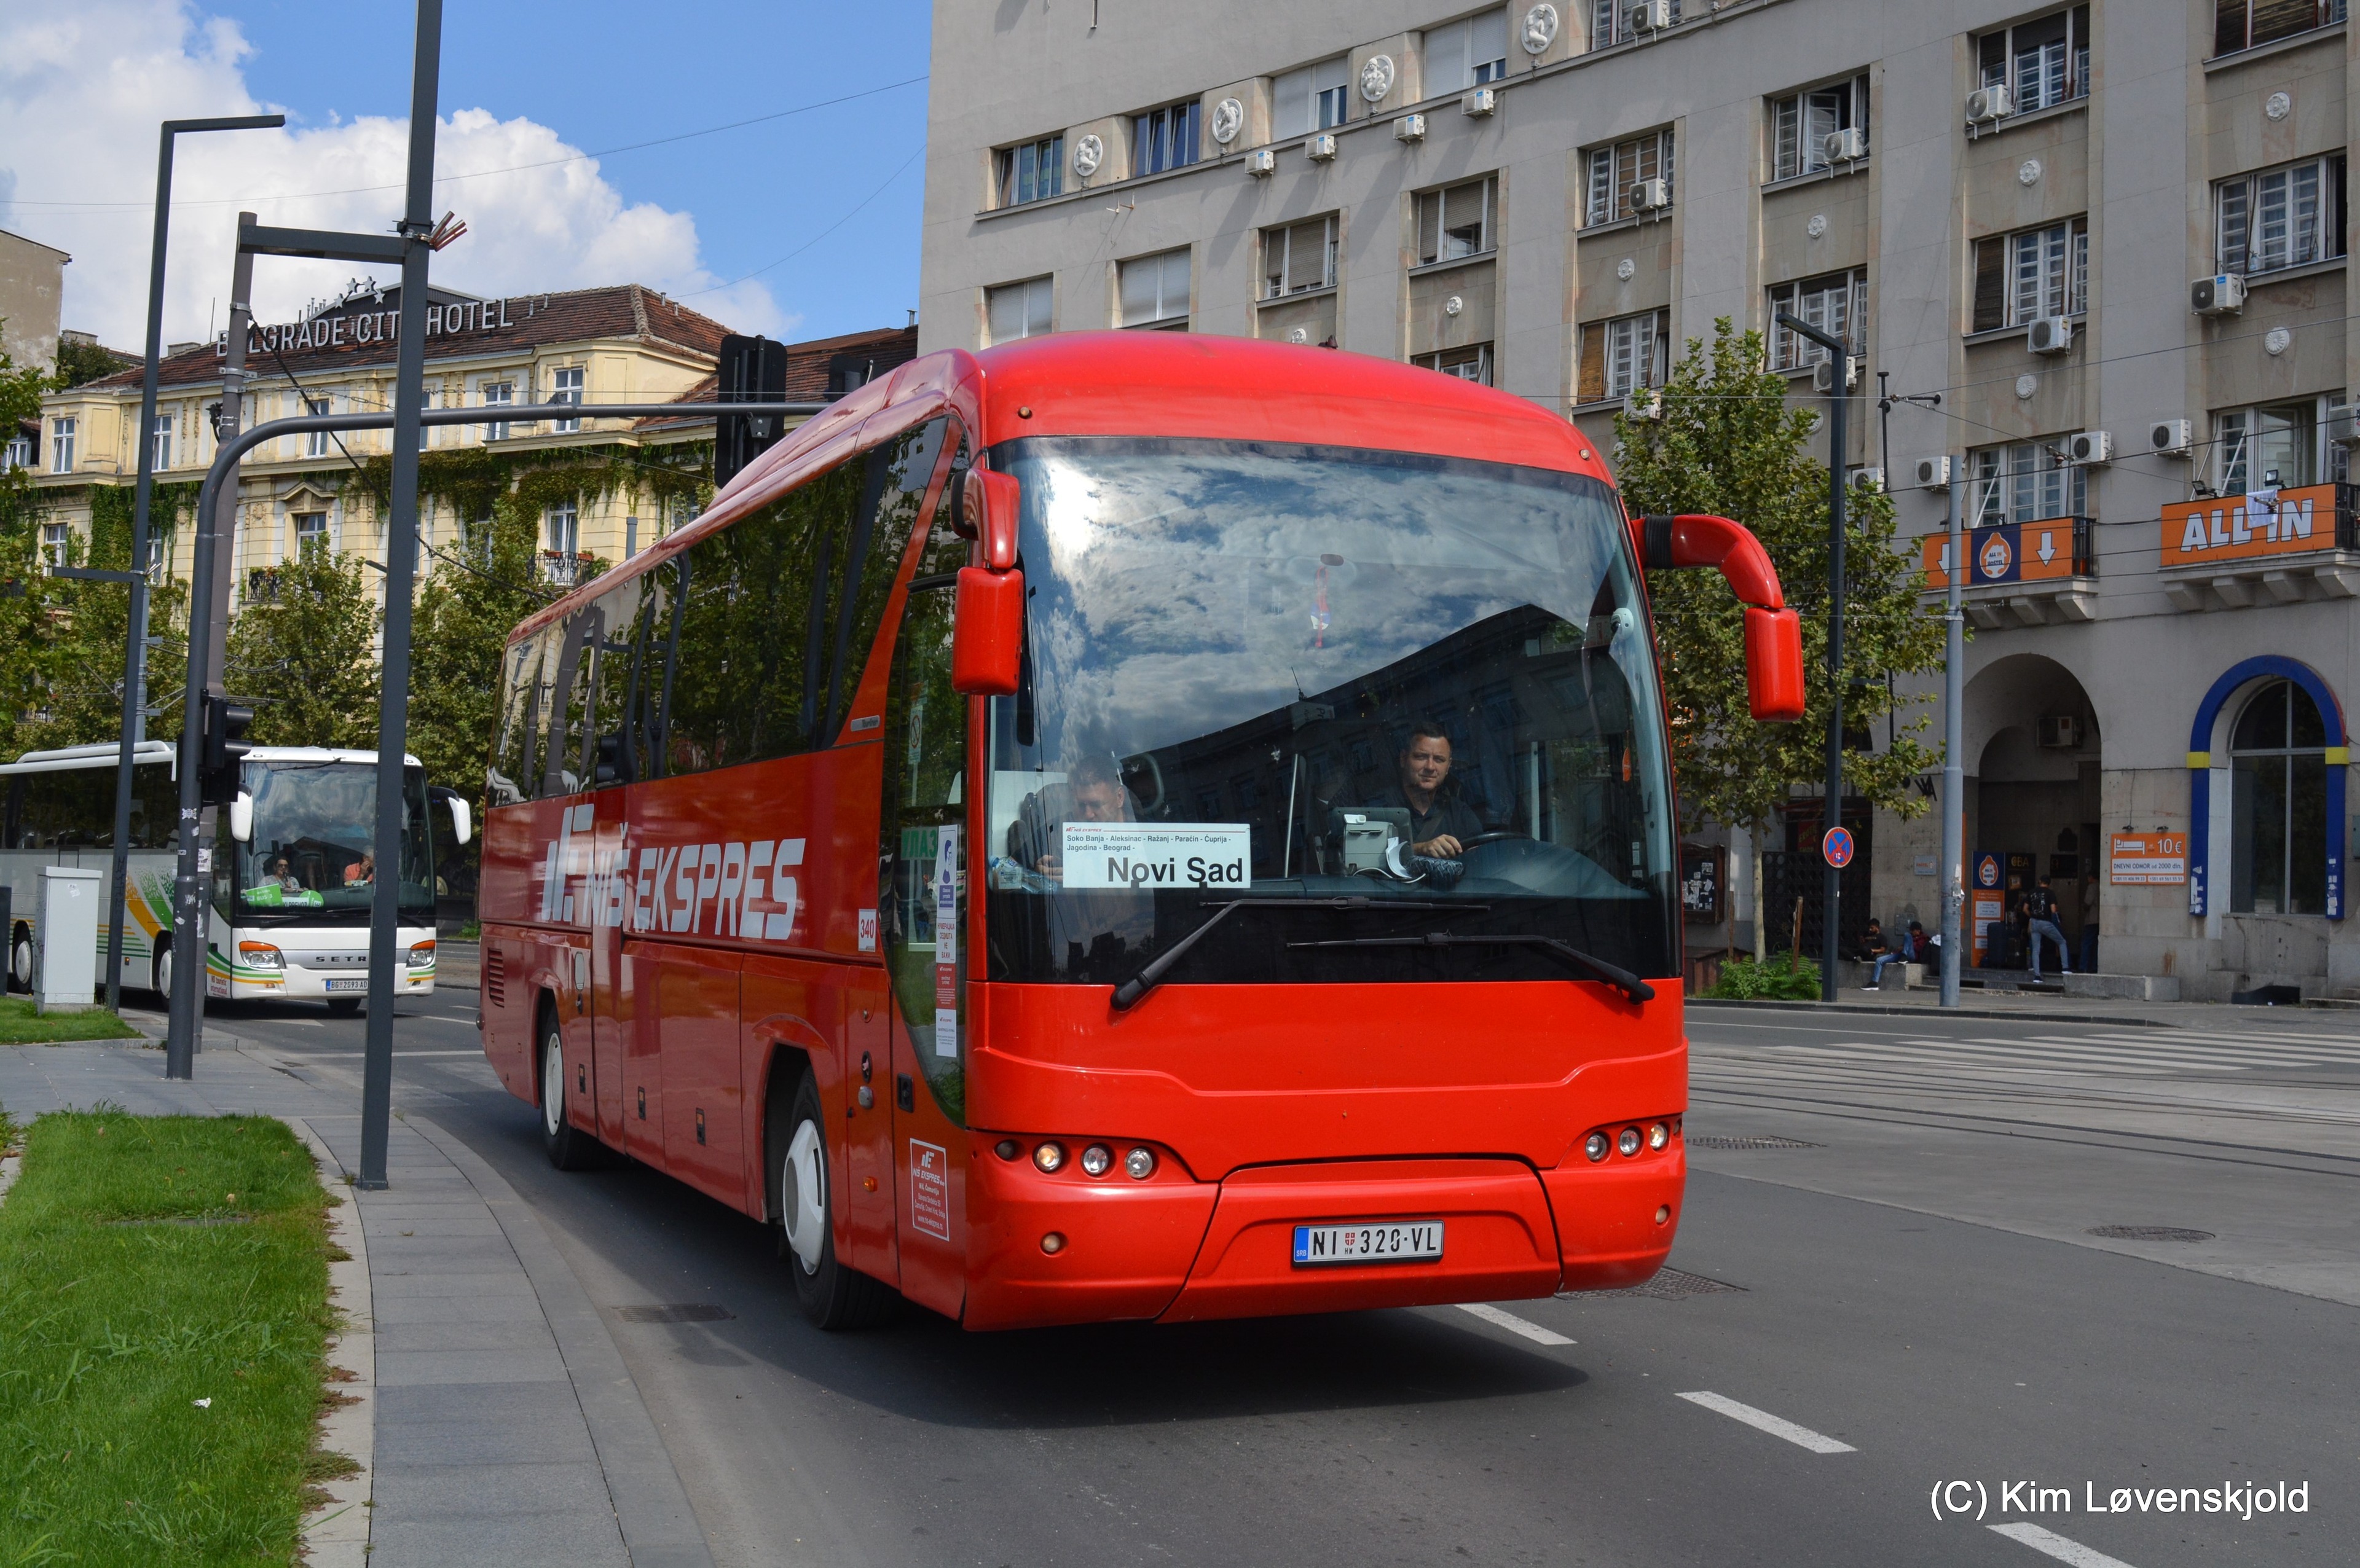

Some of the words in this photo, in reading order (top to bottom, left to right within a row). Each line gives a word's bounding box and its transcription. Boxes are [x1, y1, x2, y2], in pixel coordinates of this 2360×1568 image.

[216, 316, 346, 357] BLGRADE
[356, 310, 400, 342] CIT
[427, 298, 514, 335] HOTEL
[2180, 506, 2252, 552] ALL
[2266, 498, 2313, 543] IN
[901, 829, 937, 859] УЛАЗ
[1204, 834, 1227, 844] Ćuprija
[2158, 838, 2173, 854] 10
[2174, 841, 2182, 853] €
[582, 821, 631, 927] NIŠ
[633, 837, 806, 940] EKSPRES
[1108, 857, 1175, 883] Novi
[1187, 857, 1243, 883] Sad
[860, 919, 875, 939] 340
[921, 1170, 940, 1185] EKSPRES
[1313, 1230, 1337, 1256] NI
